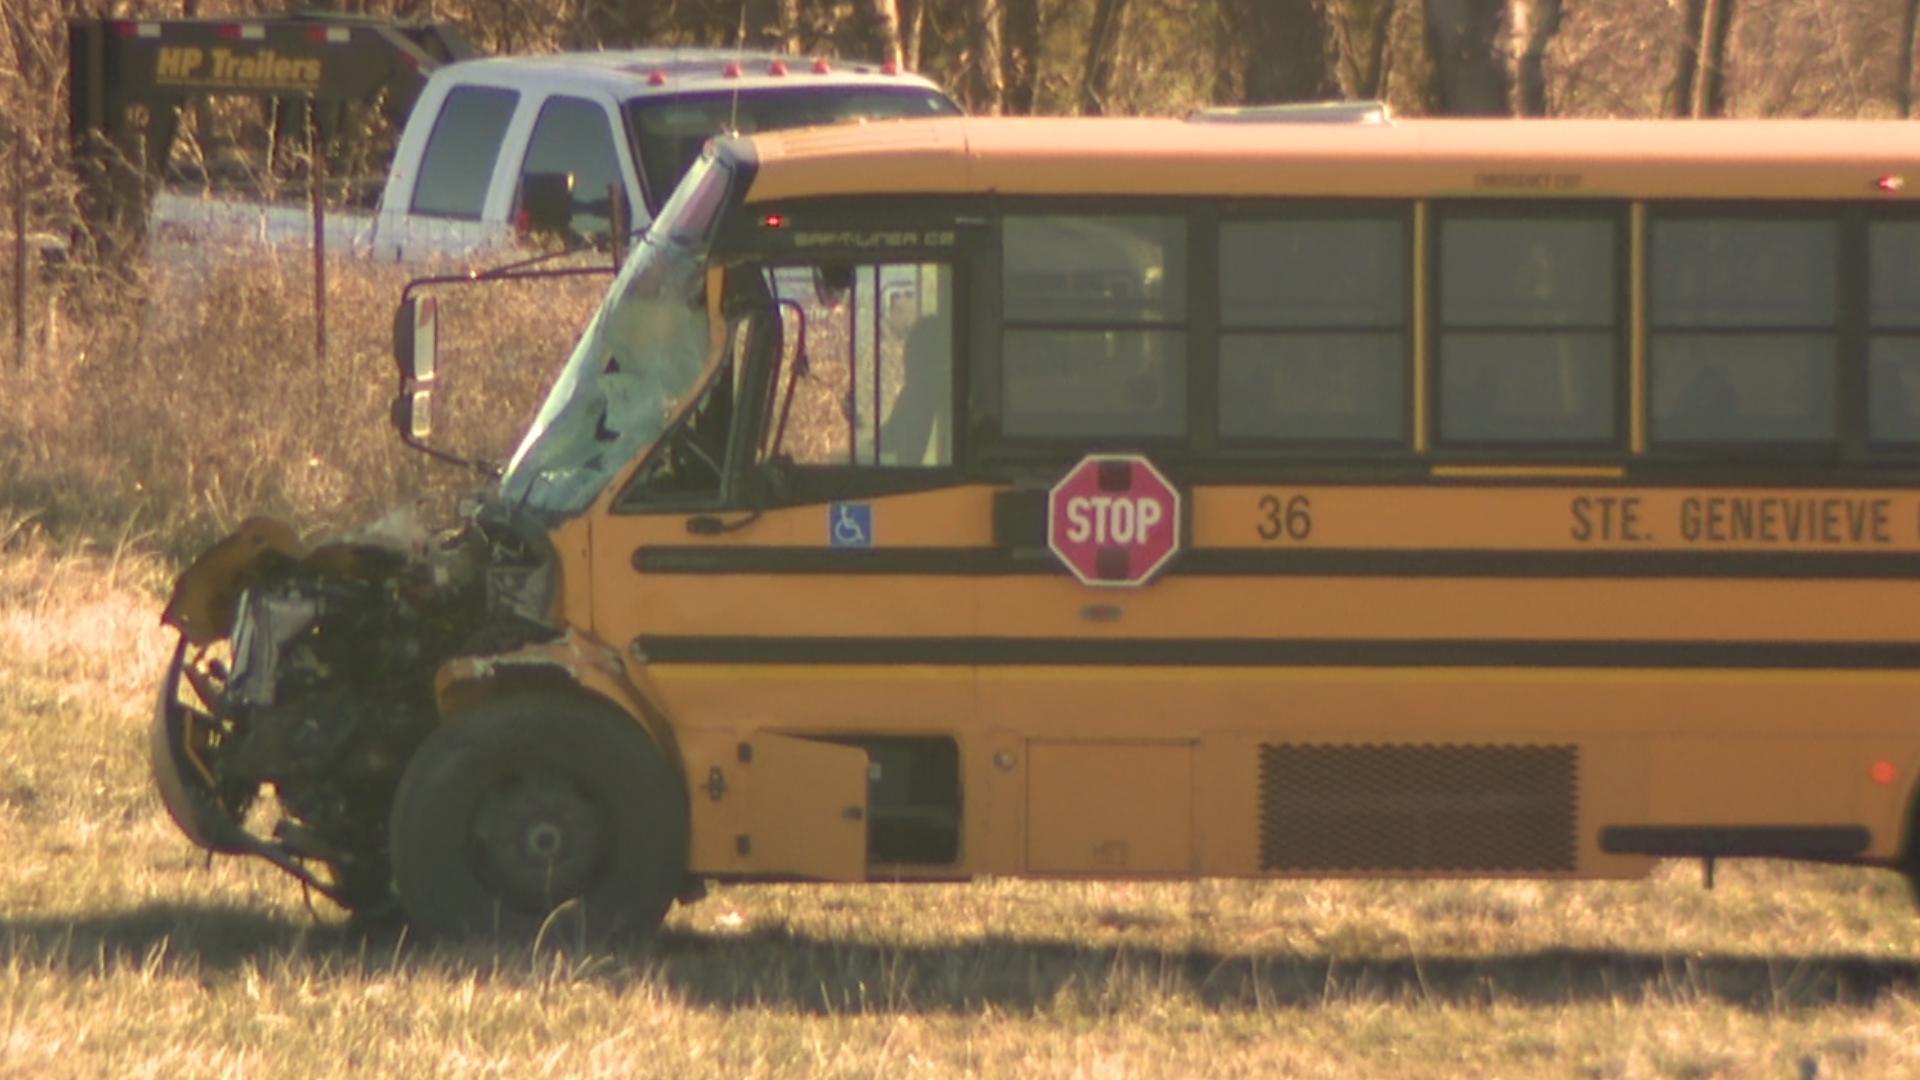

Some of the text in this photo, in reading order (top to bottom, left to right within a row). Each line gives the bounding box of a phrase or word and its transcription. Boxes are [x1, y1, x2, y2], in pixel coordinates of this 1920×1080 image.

[157, 47, 321, 81] HP Trailers
[1066, 496, 1161, 545] STOP
[1257, 494, 1312, 541] 36
[1570, 496, 1654, 542] STE.
[1679, 497, 1892, 543] GENEVIEVE
